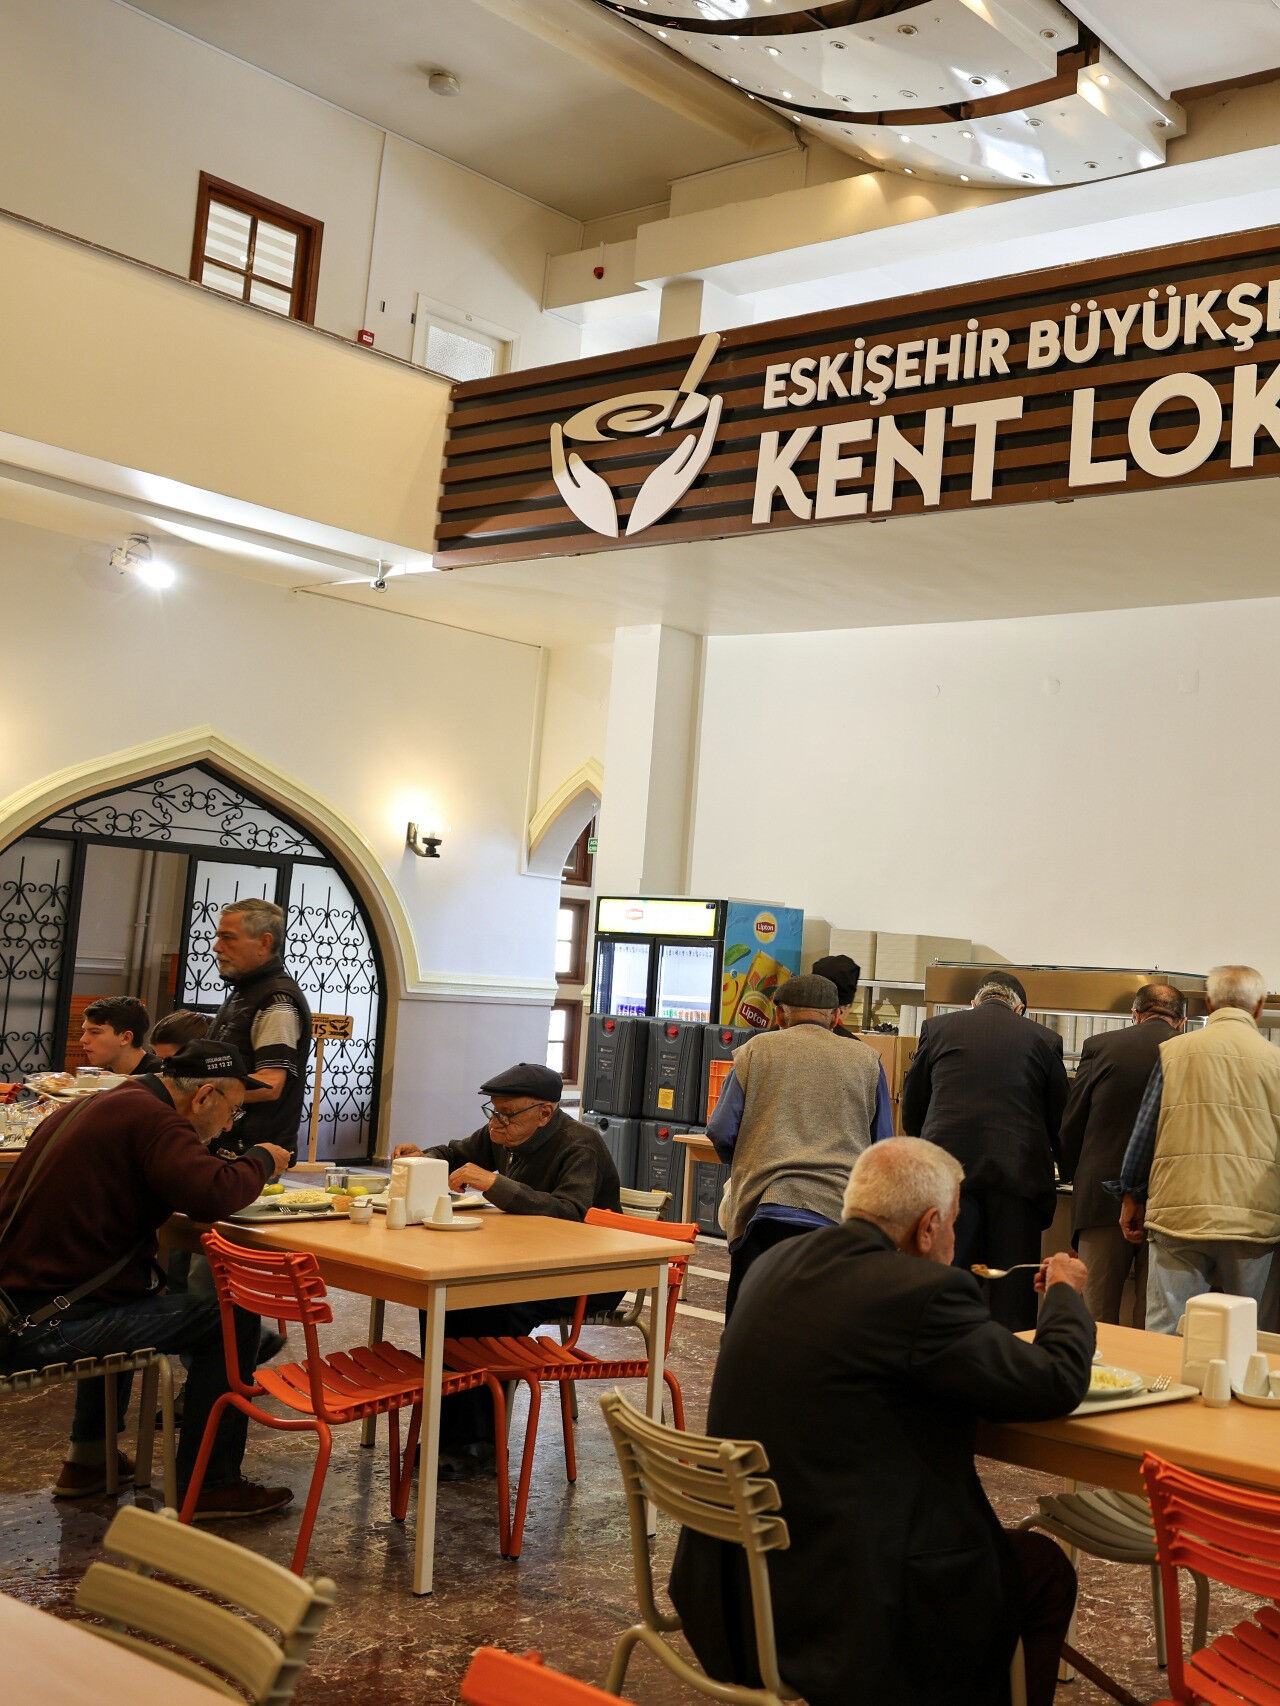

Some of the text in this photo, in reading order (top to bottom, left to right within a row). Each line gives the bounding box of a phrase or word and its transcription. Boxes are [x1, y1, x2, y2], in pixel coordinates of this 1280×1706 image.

[763, 318, 1011, 410] ESKİŞEHİR
[752, 396, 1024, 524] KENT
[757, 923, 774, 932] Lipton
[741, 1004, 768, 1027] Lipton
